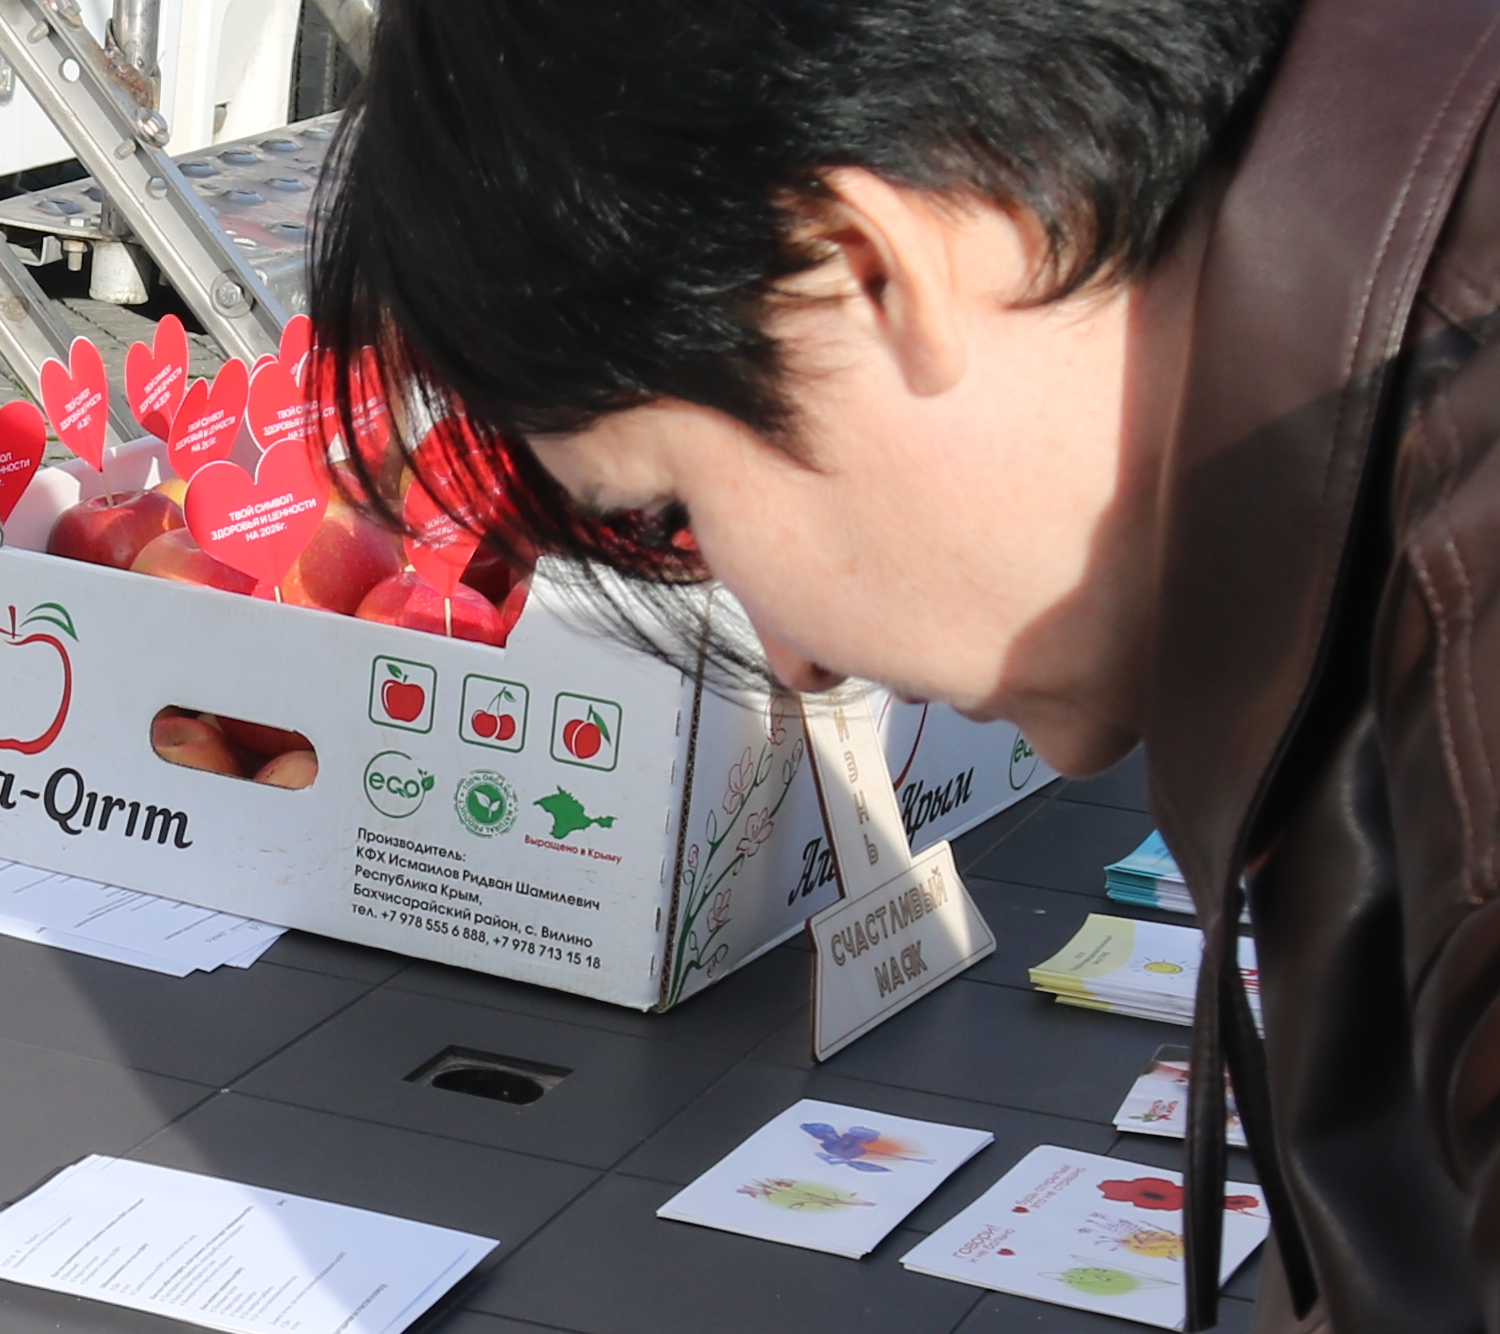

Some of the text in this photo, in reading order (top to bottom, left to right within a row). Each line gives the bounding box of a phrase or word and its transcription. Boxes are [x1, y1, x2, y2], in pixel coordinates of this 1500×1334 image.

[211, 498, 316, 540] ЗДОРОВЬЯ И ЦЕННОСТИ
[229, 493, 294, 521] ТВОЙ СИМВОЛ
[246, 522, 288, 542] НА 2026г.
[368, 771, 420, 799] eco
[357, 827, 467, 862] Производитель:
[524, 834, 622, 865] Выращено в Крыму
[354, 865, 483, 906] Республика Крым,
[355, 845, 601, 911] КФХ Исмаилов Ридван Шамилевич
[352, 904, 601, 969] тел. +7 978 555 6 888, +7 978 713 15 18
[353, 884, 593, 949] Бахчисарайский район, с. Вилино
[831, 868, 951, 967] СЧАСТЛИВЫЙ
[873, 940, 929, 998] МАЯК
